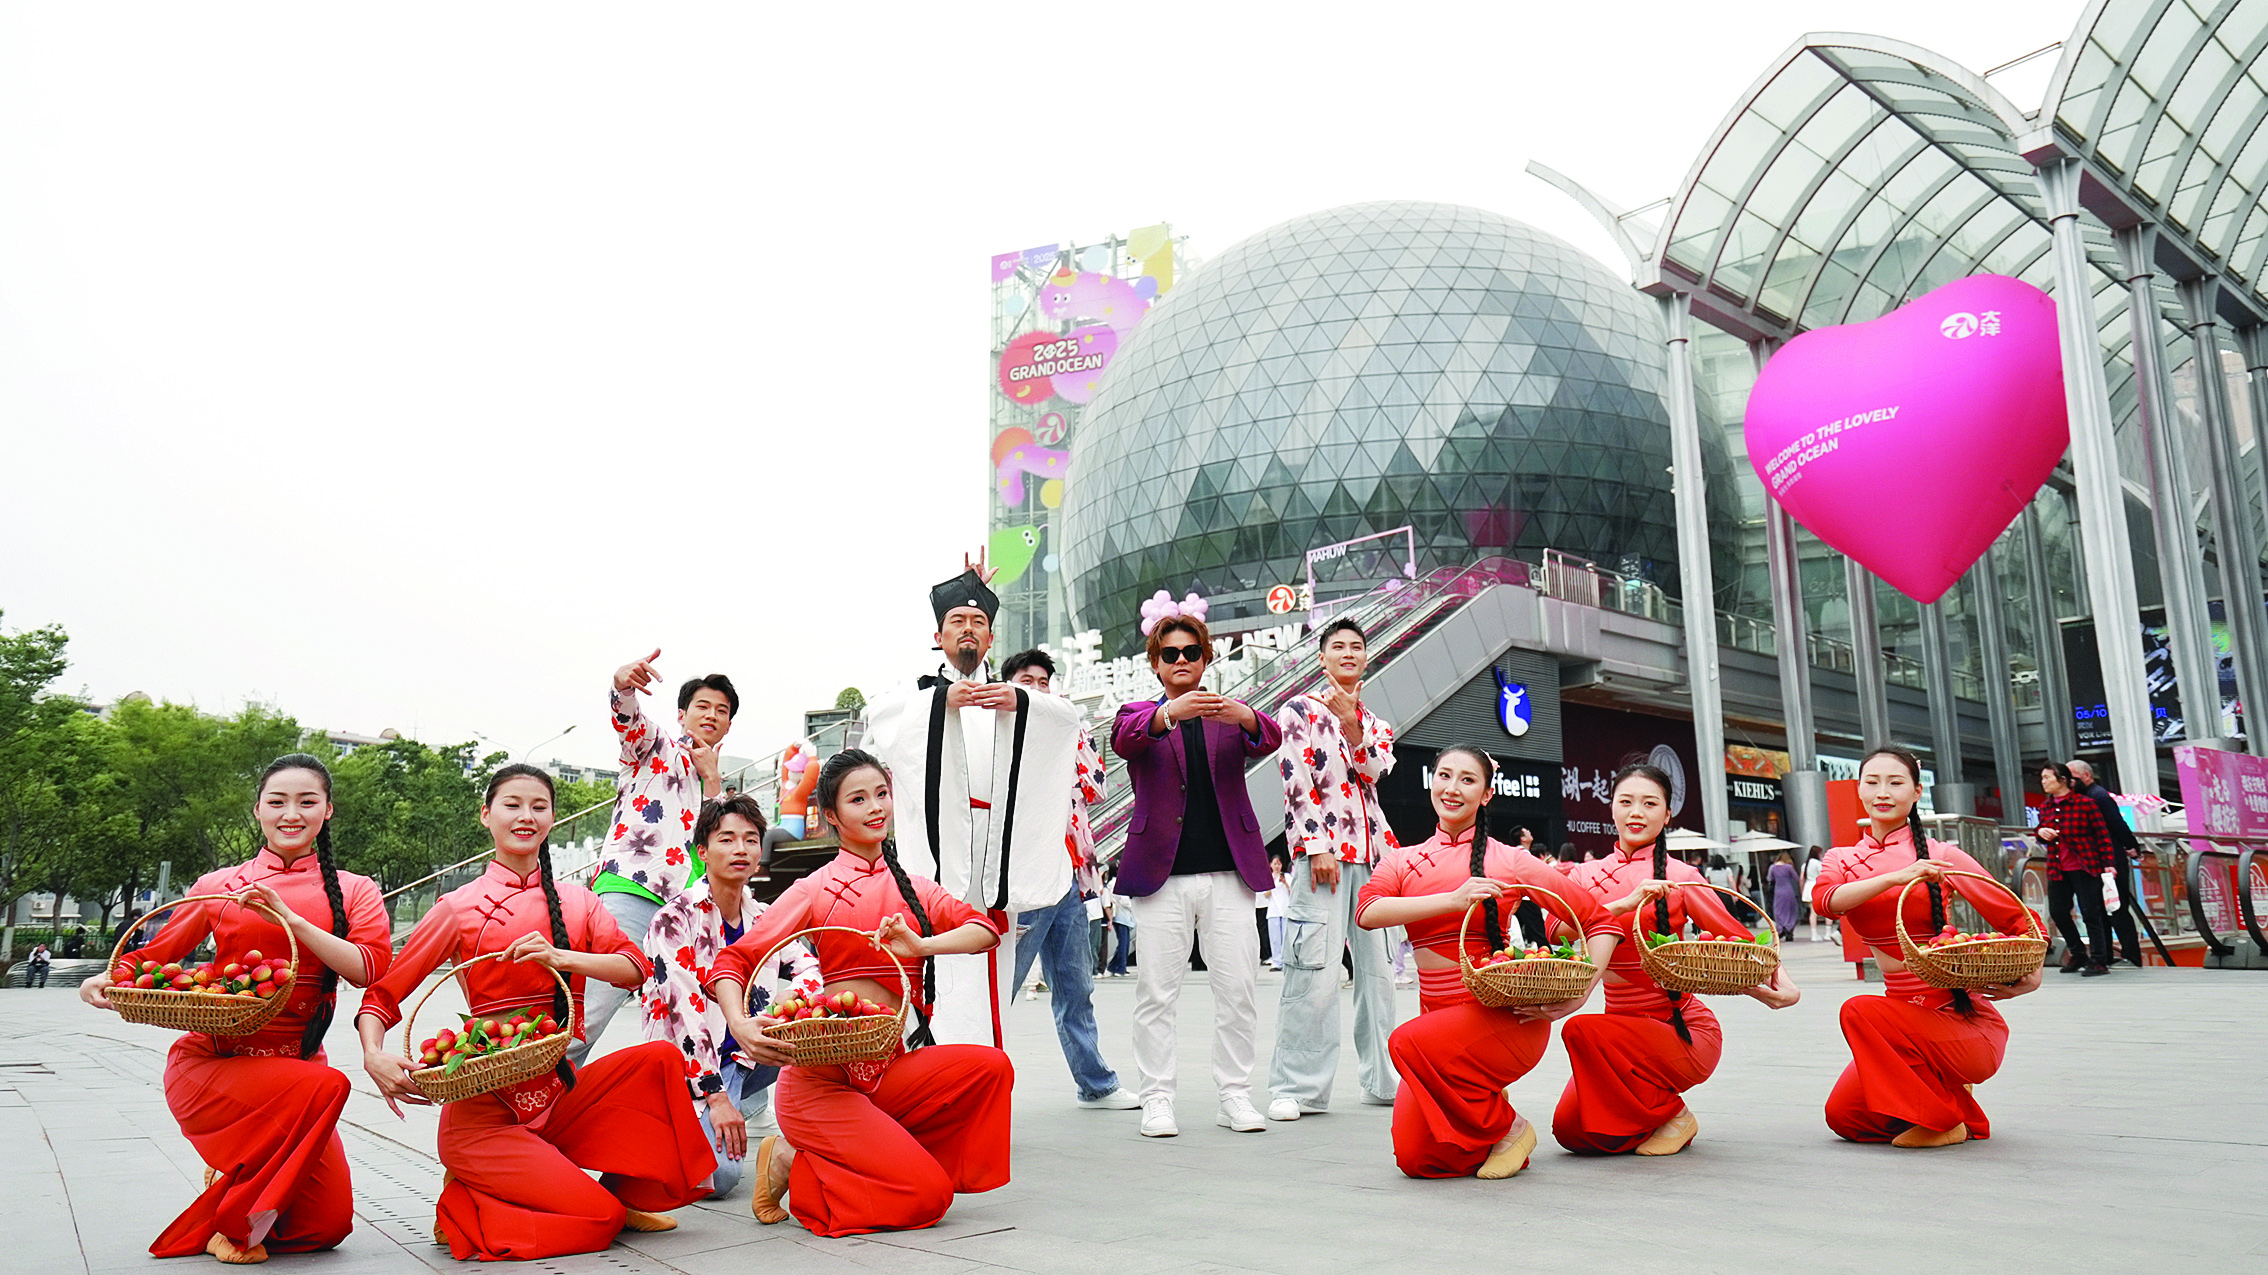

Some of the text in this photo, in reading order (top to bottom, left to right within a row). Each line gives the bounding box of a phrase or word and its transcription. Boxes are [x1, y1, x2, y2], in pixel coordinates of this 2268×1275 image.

[1980, 310, 2001, 337] 大洋
[1033, 339, 1079, 362] 2025
[1009, 353, 1103, 381] GRAND OCEAN
[1764, 406, 1900, 475] WELCOME TO THE LOVELY
[1771, 460, 1798, 490] GRAND
[1797, 437, 1839, 467] OCEAN
[1241, 622, 1303, 660] NEW
[1733, 781, 1775, 801] KIEHL'S
[1576, 821, 1601, 834] COFFEE
